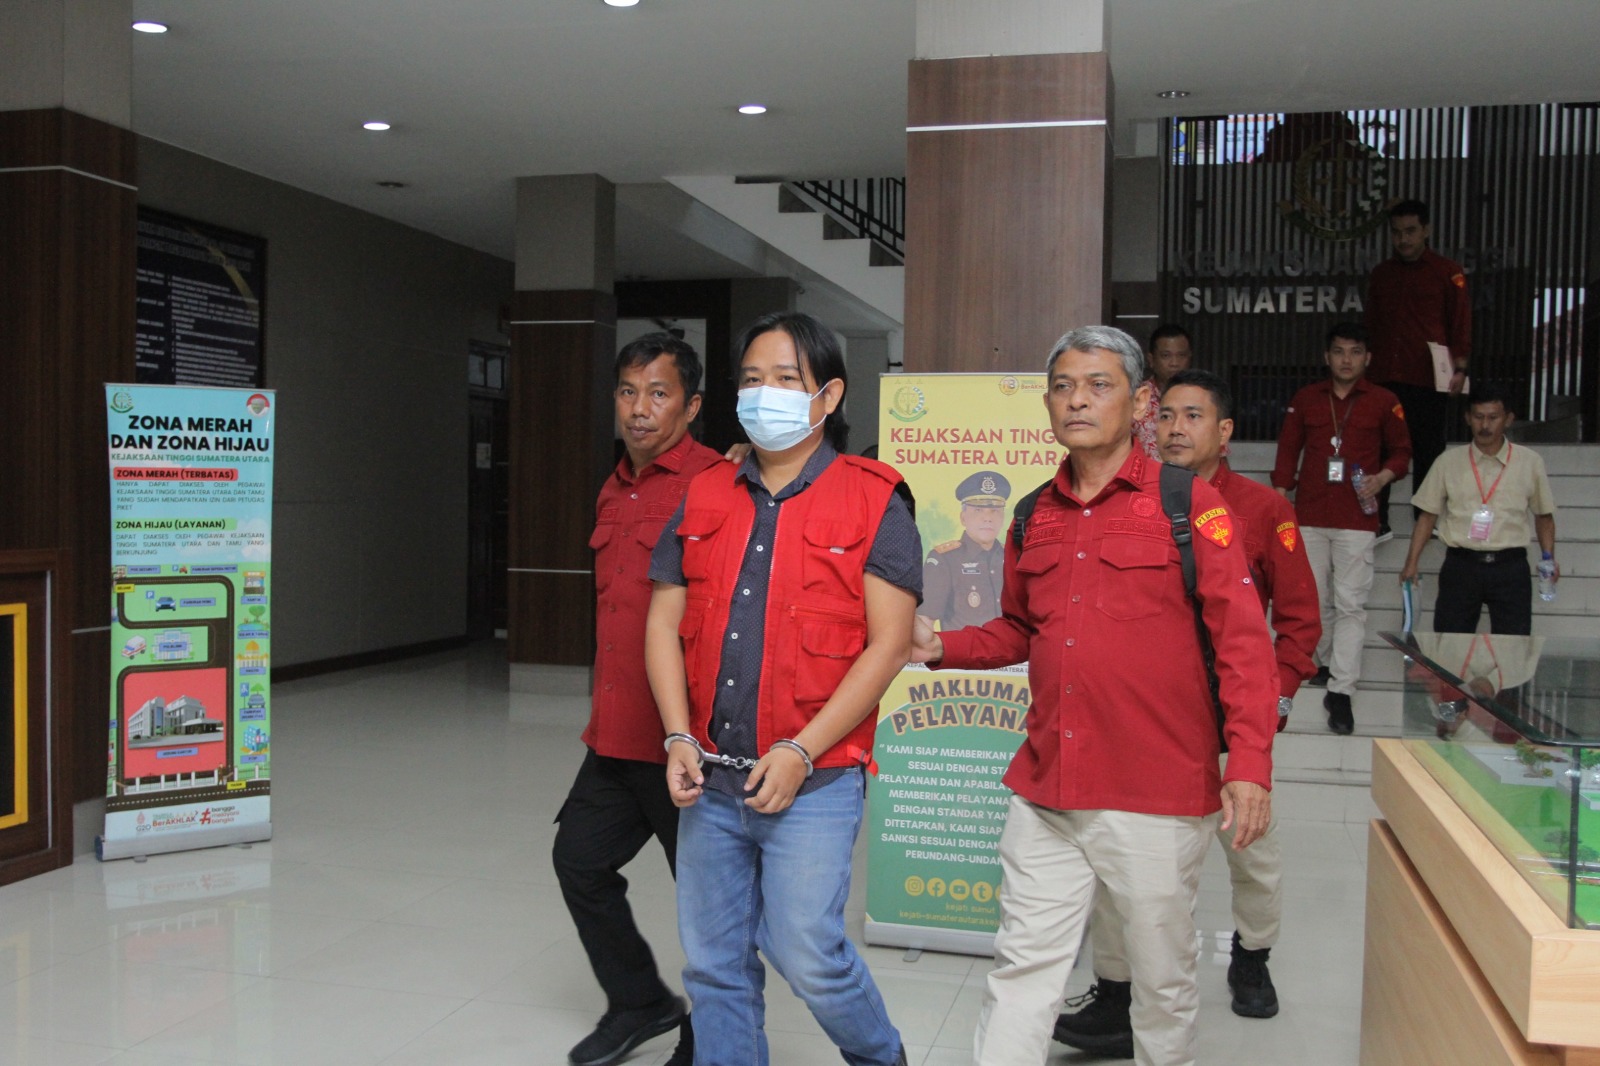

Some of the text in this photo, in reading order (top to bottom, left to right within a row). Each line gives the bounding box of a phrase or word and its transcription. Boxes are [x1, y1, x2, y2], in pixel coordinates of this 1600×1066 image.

[1183, 286, 1364, 314] SUMATERA
[128, 415, 252, 432] ZONA MERAH
[111, 434, 269, 452] DAN ZONA HIJAU
[890, 428, 1056, 444] KEJAKSAAN TING
[895, 449, 999, 465] SUMATERA
[117, 469, 234, 479] ZONA MERAH (TERBATAS)
[175, 520, 225, 530] (LAYANAN)
[909, 678, 1029, 706] MAKLUMA
[892, 704, 1028, 733] PELAYAN
[887, 745, 913, 754] KAMI
[916, 746, 938, 756] SIAP
[940, 748, 1007, 760] MEMBERIKAN
[908, 761, 944, 771] SESUAI
[946, 763, 988, 774] DENGAN
[879, 774, 1006, 790] PELAYANAN DAN APABILA
[889, 790, 1010, 806] MEMBERIKAN PELAYANA
[894, 804, 1008, 820] DENGAN STANDAR YAN
[885, 818, 1002, 835] DITETAPKAN, KAMI SIAP
[881, 833, 917, 843] SANKSI
[920, 836, 956, 846] SESUAI
